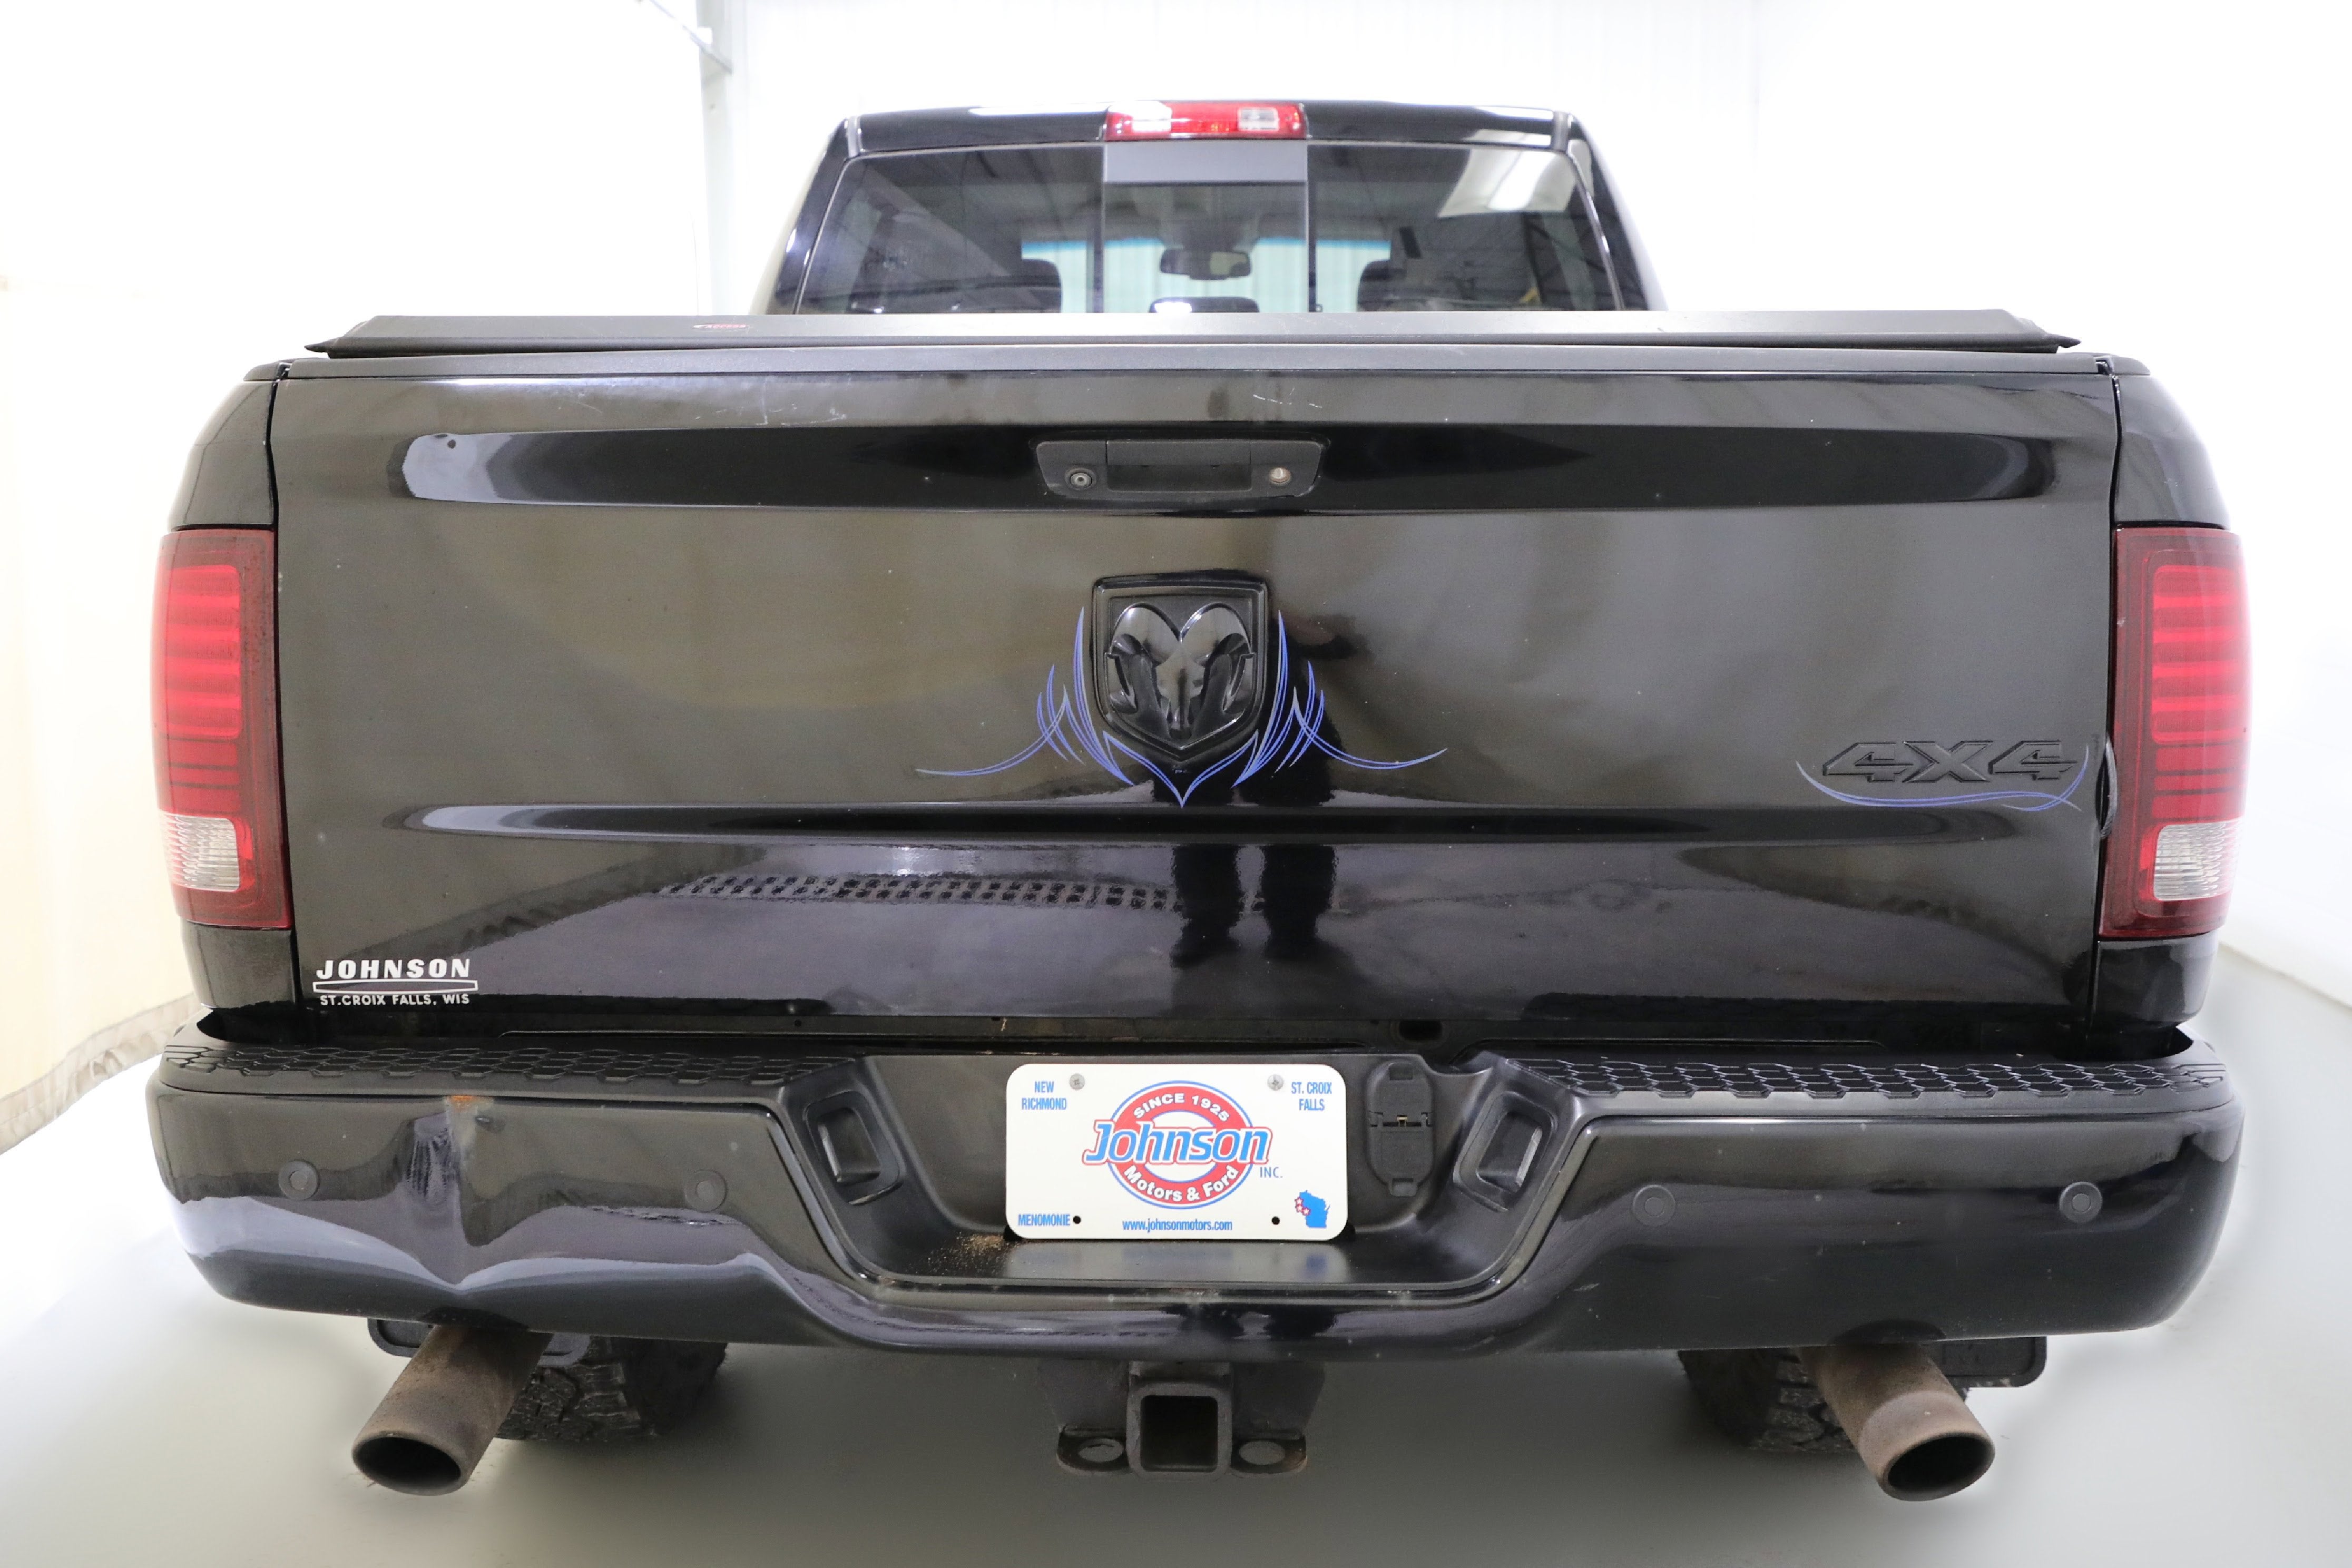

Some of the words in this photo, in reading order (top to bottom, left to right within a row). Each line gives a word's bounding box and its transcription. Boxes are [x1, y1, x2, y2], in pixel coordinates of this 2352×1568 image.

[316, 958, 470, 979] JOHNSON
[320, 995, 386, 1006] ST.CROIX
[392, 994, 437, 1005] FALLS,
[442, 993, 470, 1005] WIS
[1034, 1081, 1054, 1093] NEW
[1291, 1082, 1304, 1094] ST.
[1307, 1082, 1332, 1094] CROIX
[1022, 1097, 1067, 1110] RICHMOND
[1133, 1093, 1185, 1120] SINCE
[1191, 1095, 1230, 1122] 1925
[1299, 1099, 1325, 1111] FALLS
[1082, 1120, 1273, 1165] Johnson
[1259, 1167, 1283, 1178] INC.
[1123, 1165, 1183, 1202] Motors
[1187, 1188, 1199, 1202] &
[1201, 1165, 1239, 1198] Ford
[1018, 1213, 1071, 1227] MENOMONIE
[1122, 1219, 1232, 1231] www.johnsonmotors.com
